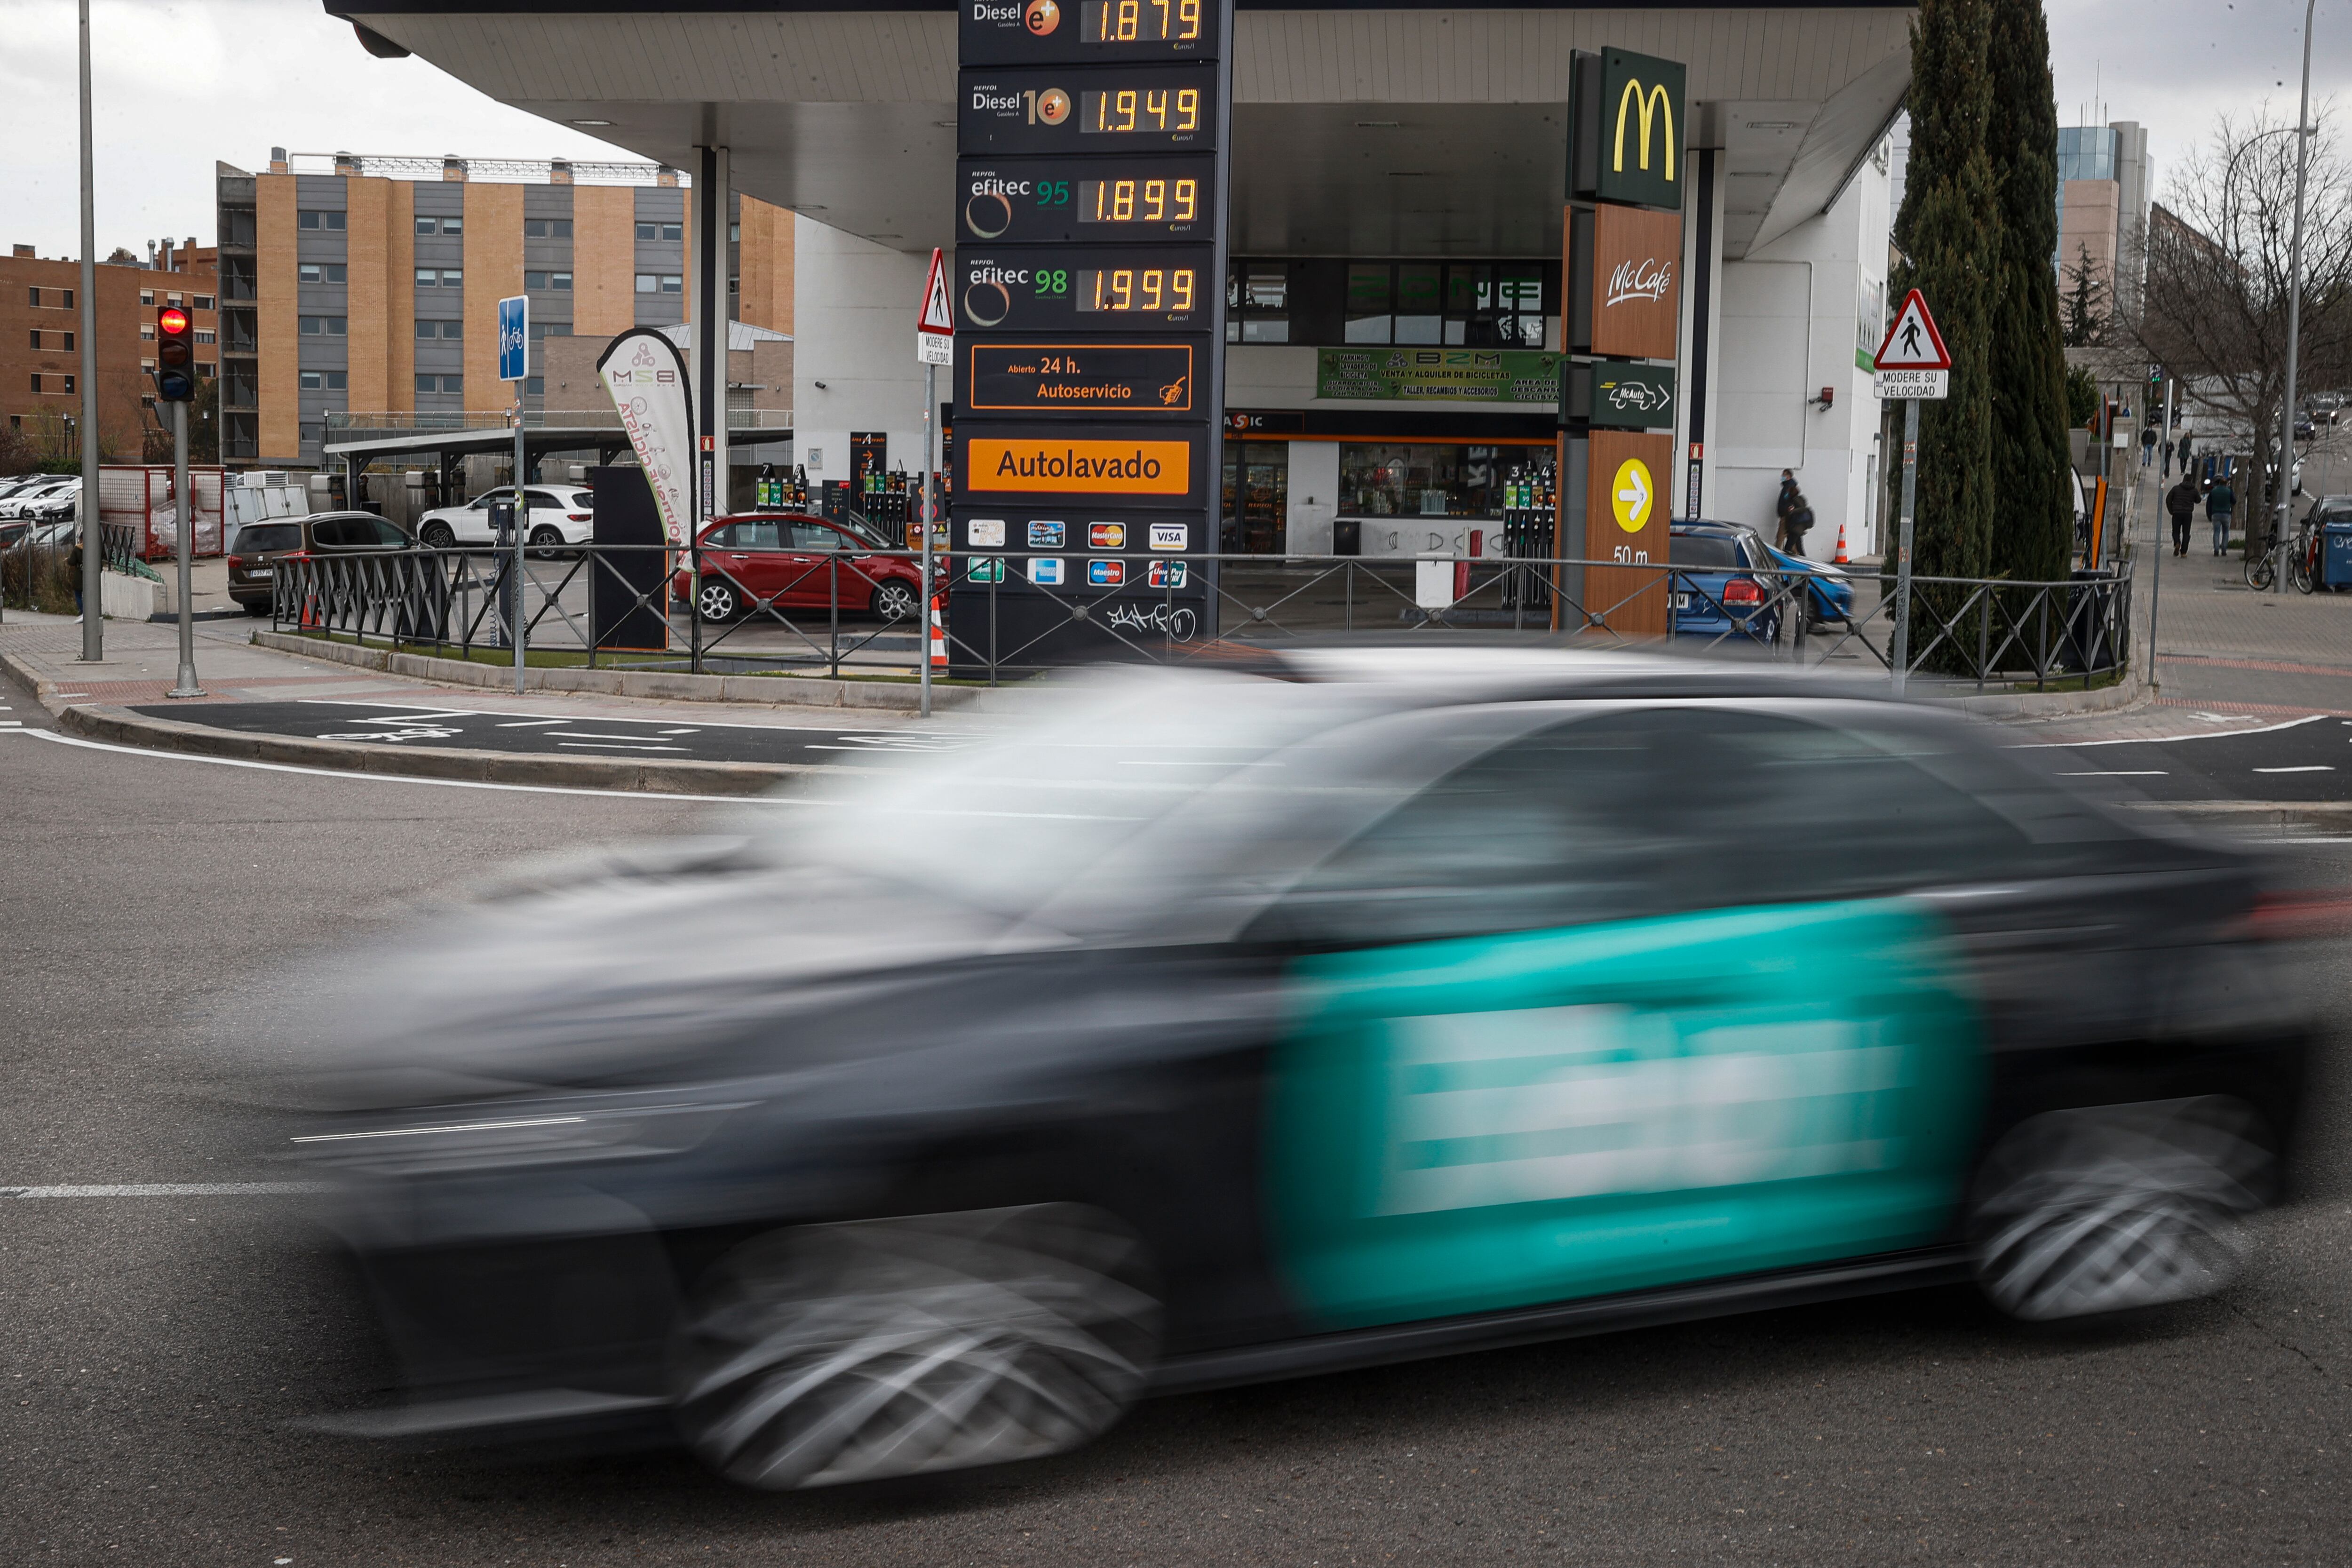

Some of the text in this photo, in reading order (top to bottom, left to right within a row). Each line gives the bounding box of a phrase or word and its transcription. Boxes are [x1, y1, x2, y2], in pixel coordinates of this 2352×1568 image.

[974, 2, 1020, 21] Diesel
[1100, 0, 1200, 40] 1.879
[973, 92, 1020, 111] Diesel
[1099, 88, 1198, 131] 1.949
[971, 179, 1069, 205] efitec 95
[1097, 179, 1196, 221] 1.899
[970, 267, 1067, 294] efitec 98
[1350, 275, 1540, 299] ZONE
[1607, 258, 1672, 303] McCafé
[1095, 269, 1193, 310] 1.999
[925, 336, 950, 350] MODERE SU
[926, 350, 949, 364] VELOCIDAD
[1008, 356, 1081, 374] Abierto 24 h.
[1381, 370, 1406, 379] VENTA
[1414, 370, 1452, 379] ALQUILER
[1465, 371, 1510, 380] BICICLETAS
[1883, 372, 1937, 383] MODERE SU
[1036, 384, 1131, 398] Autoservicio
[1402, 385, 1425, 396] TALLER,
[1426, 385, 1458, 395] RECAMBIOS
[1463, 386, 1498, 396] ACCESORIOS
[1620, 388, 1645, 400] McAuto
[1883, 386, 1936, 397] VELOCIDAD
[763, 464, 769, 475] 7
[795, 465, 801, 476] 8
[868, 460, 873, 469] 5
[996, 449, 1161, 479] Autolavado
[1526, 461, 1531, 470] 1
[1511, 466, 1519, 477] 3
[1542, 466, 1549, 478] 4
[1156, 532, 1181, 542] VISA
[1613, 546, 1648, 564] 50 m
